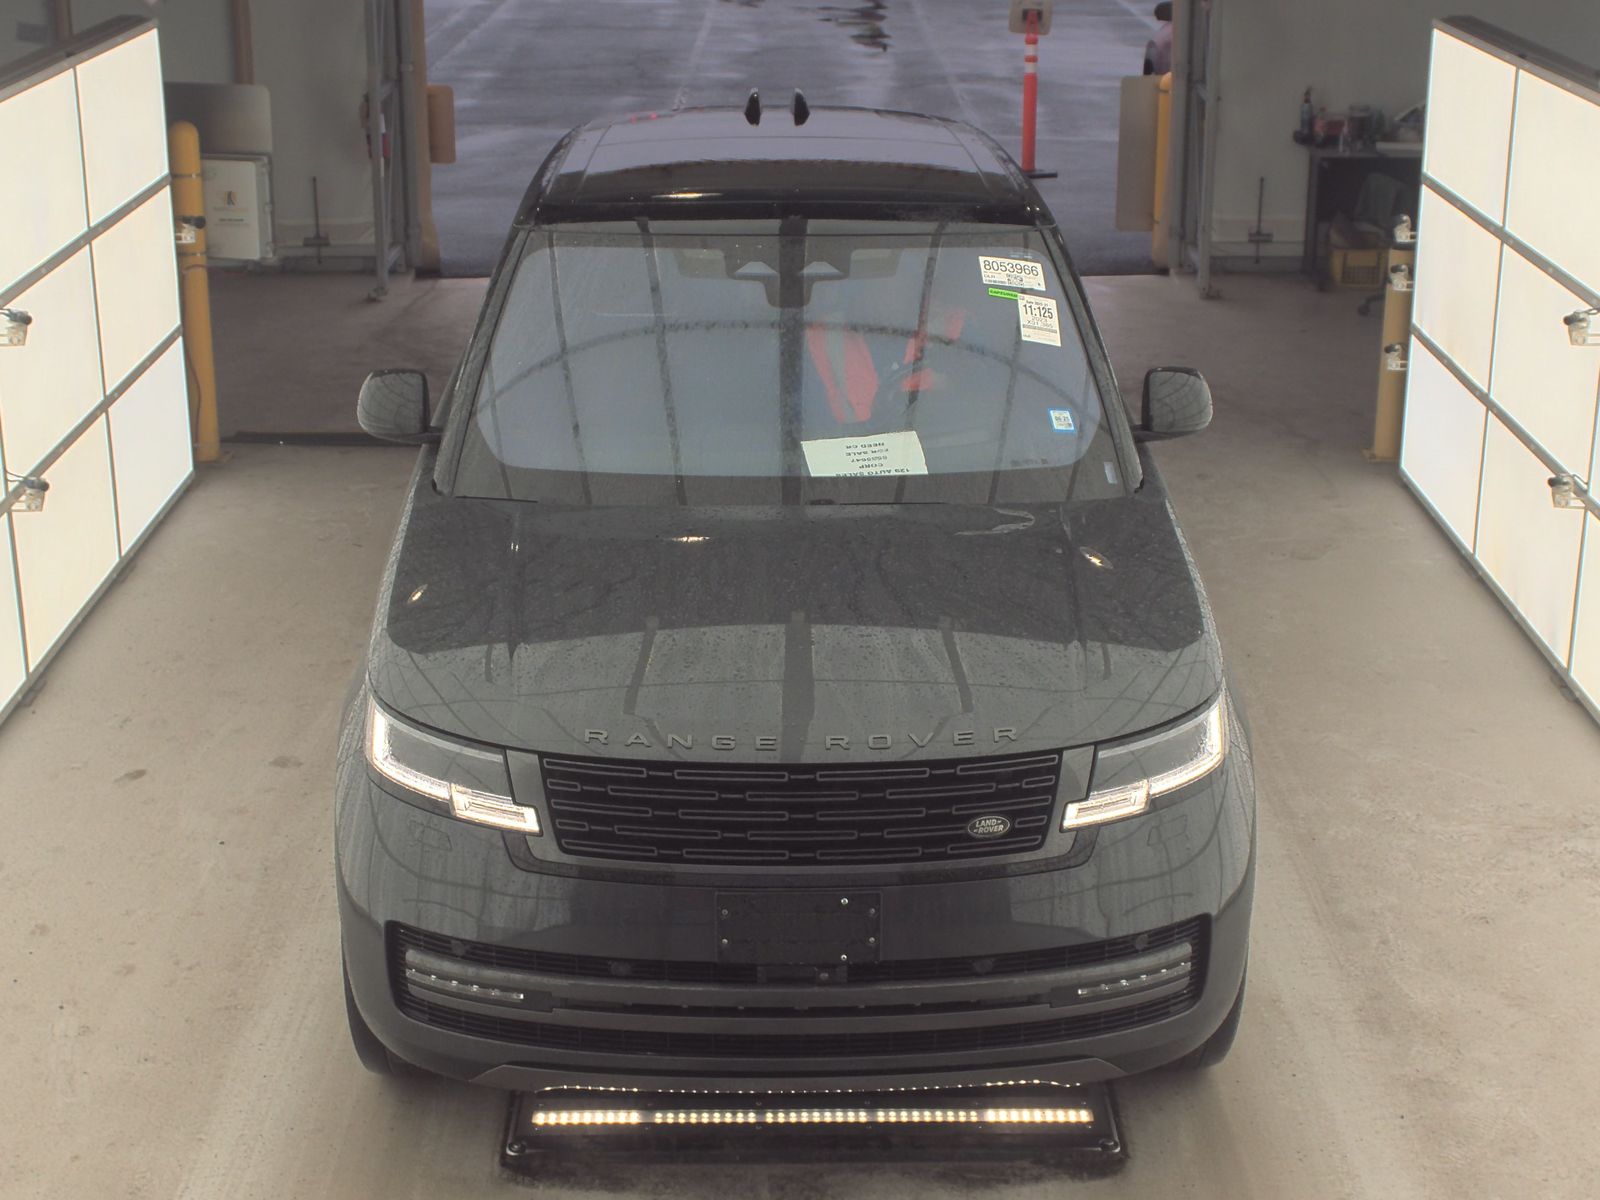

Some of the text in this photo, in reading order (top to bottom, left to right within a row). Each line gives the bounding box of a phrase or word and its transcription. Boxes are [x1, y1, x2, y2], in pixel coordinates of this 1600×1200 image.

[983, 260, 1039, 277] 8053966
[1023, 304, 1053, 320] 11:125
[584, 727, 1018, 751] RANGE ROVER
[976, 819, 997, 828] LAND
[978, 825, 1004, 834] ROVER
